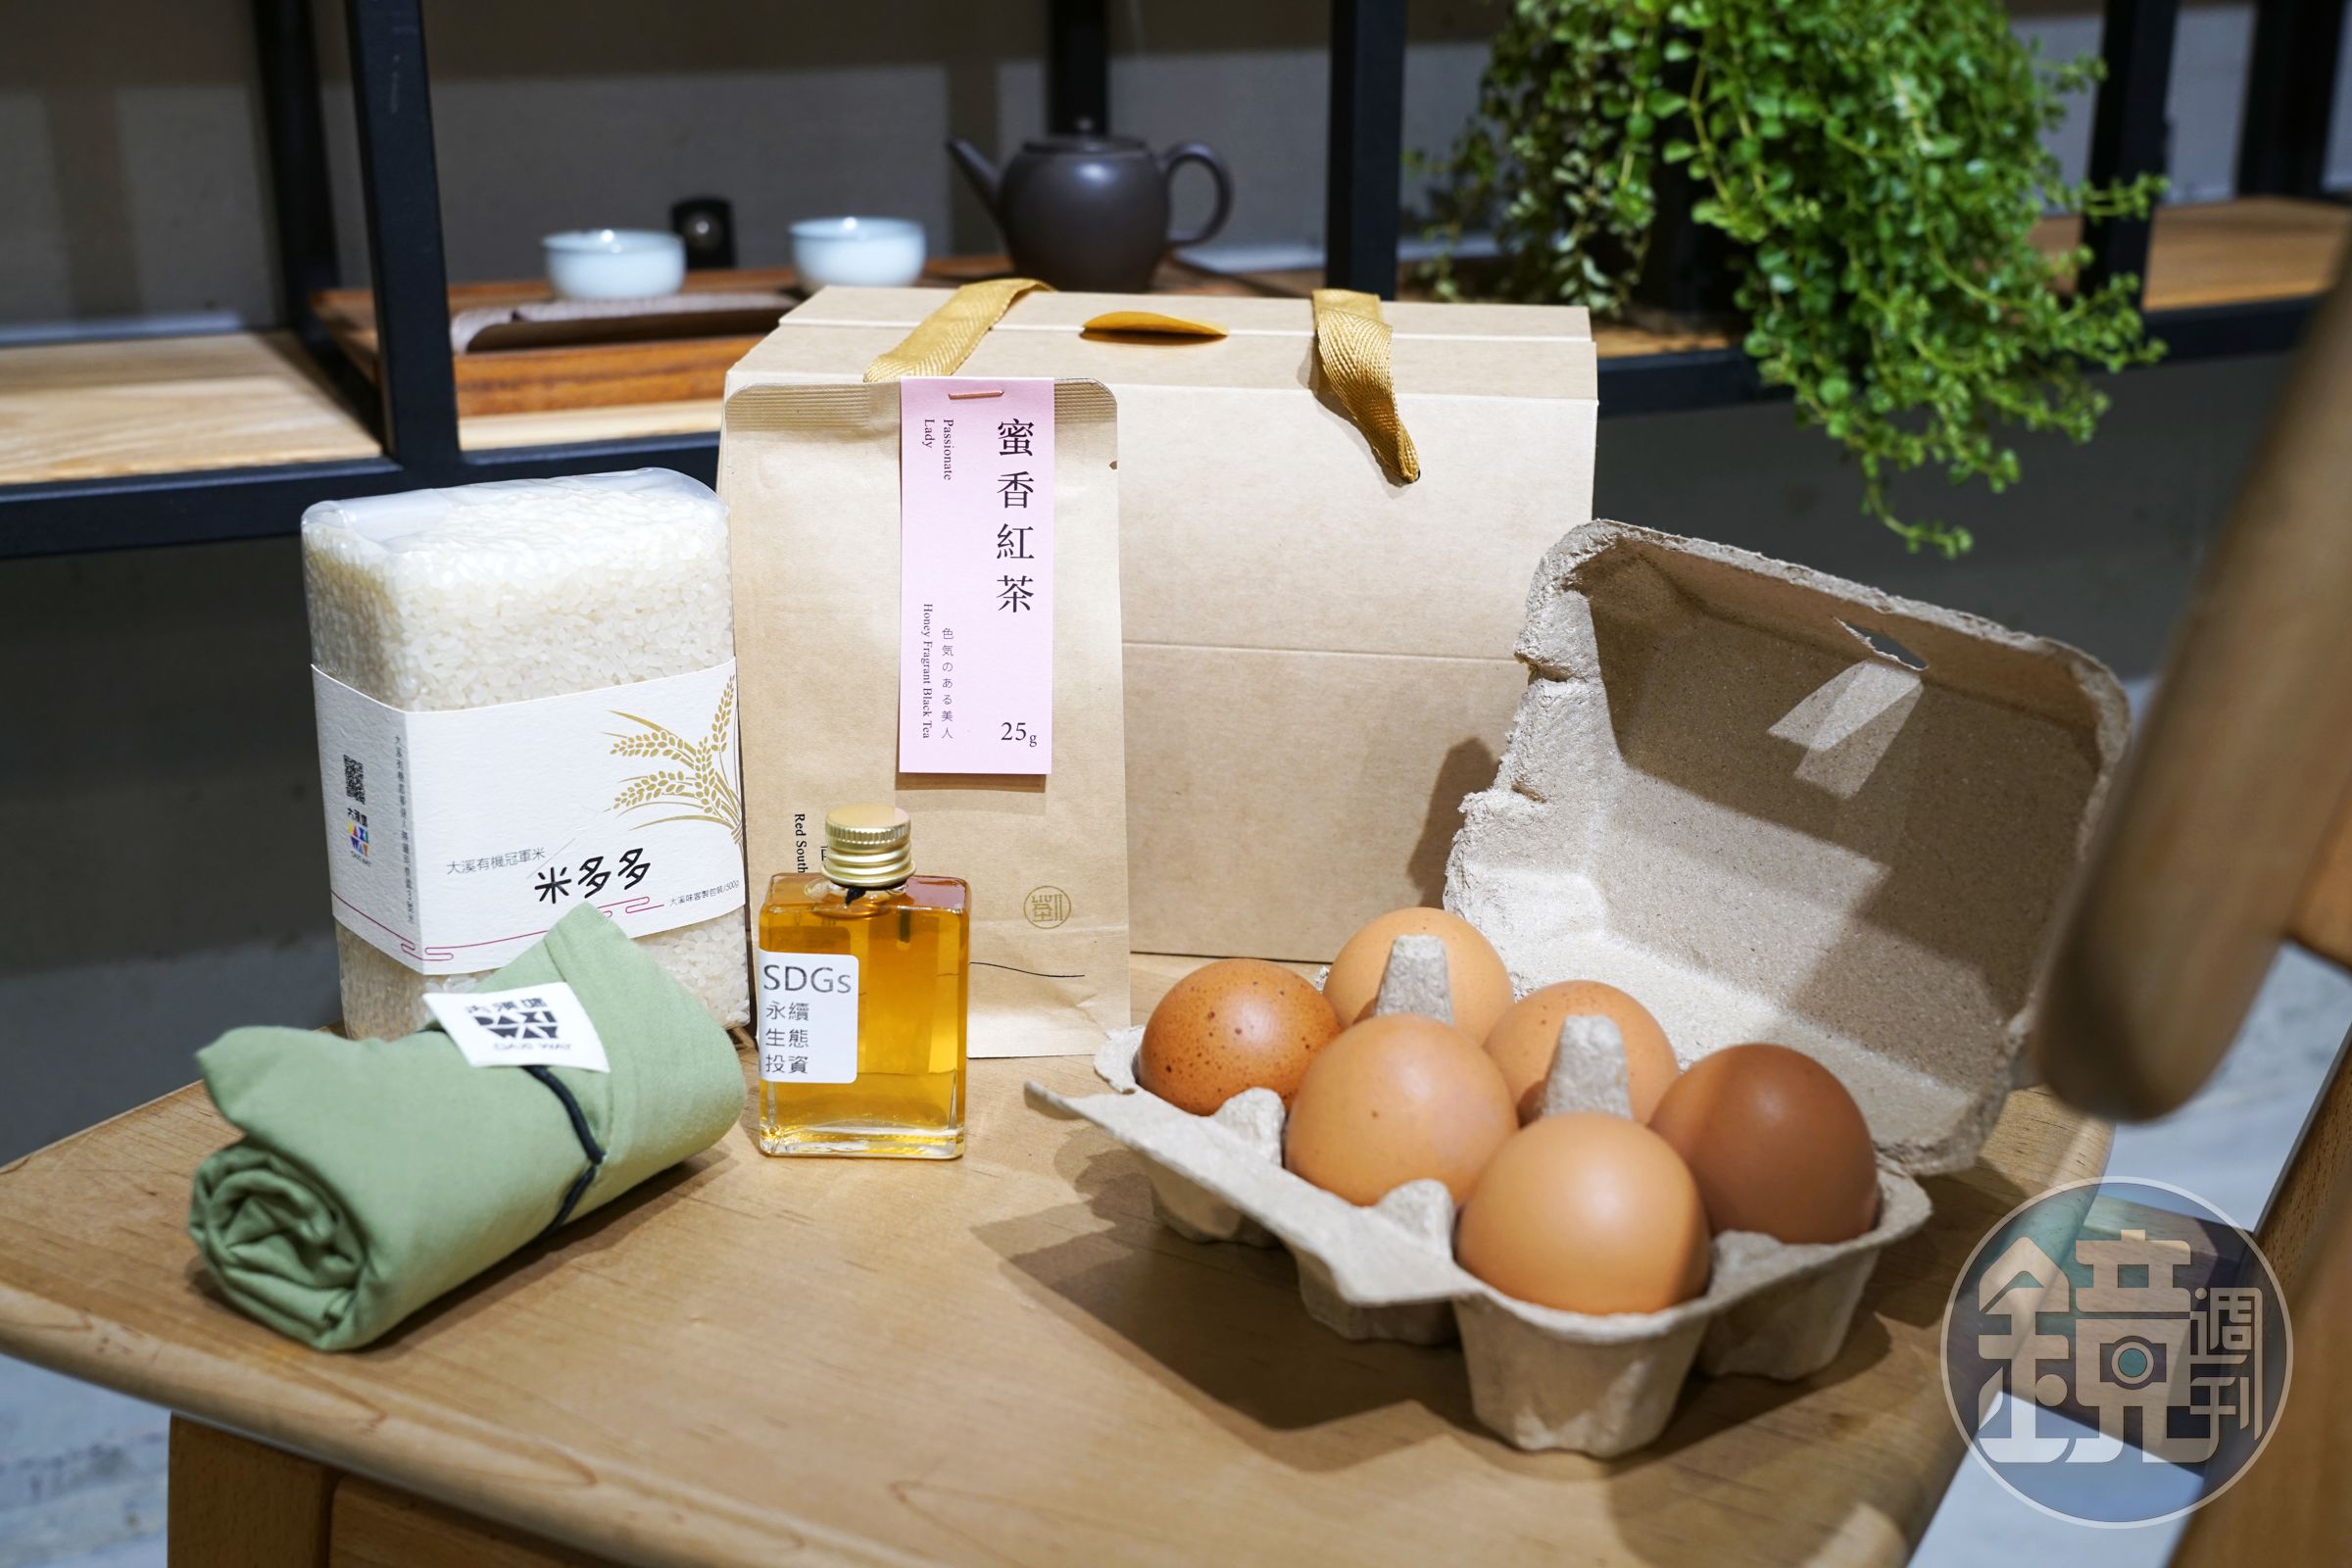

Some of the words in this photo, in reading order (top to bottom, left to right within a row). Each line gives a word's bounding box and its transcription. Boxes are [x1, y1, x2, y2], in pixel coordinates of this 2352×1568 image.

[922, 418, 935, 450] Lady
[943, 418, 955, 481] Passionate
[996, 418, 1035, 613] 蜜香紅茶
[921, 604, 934, 637] Honey
[921, 641, 934, 684] Fragrant
[941, 627, 955, 739] 色気のある美人
[922, 688, 933, 717] Black
[922, 720, 933, 739] Tea
[795, 813, 808, 836] Red
[447, 847, 546, 875] 大溪有機冠軍米
[534, 848, 652, 905] 米多多
[763, 964, 852, 995] SDGs
[765, 1002, 809, 1022] 永續
[765, 1027, 809, 1049] 生態
[764, 1054, 809, 1075] 投資
